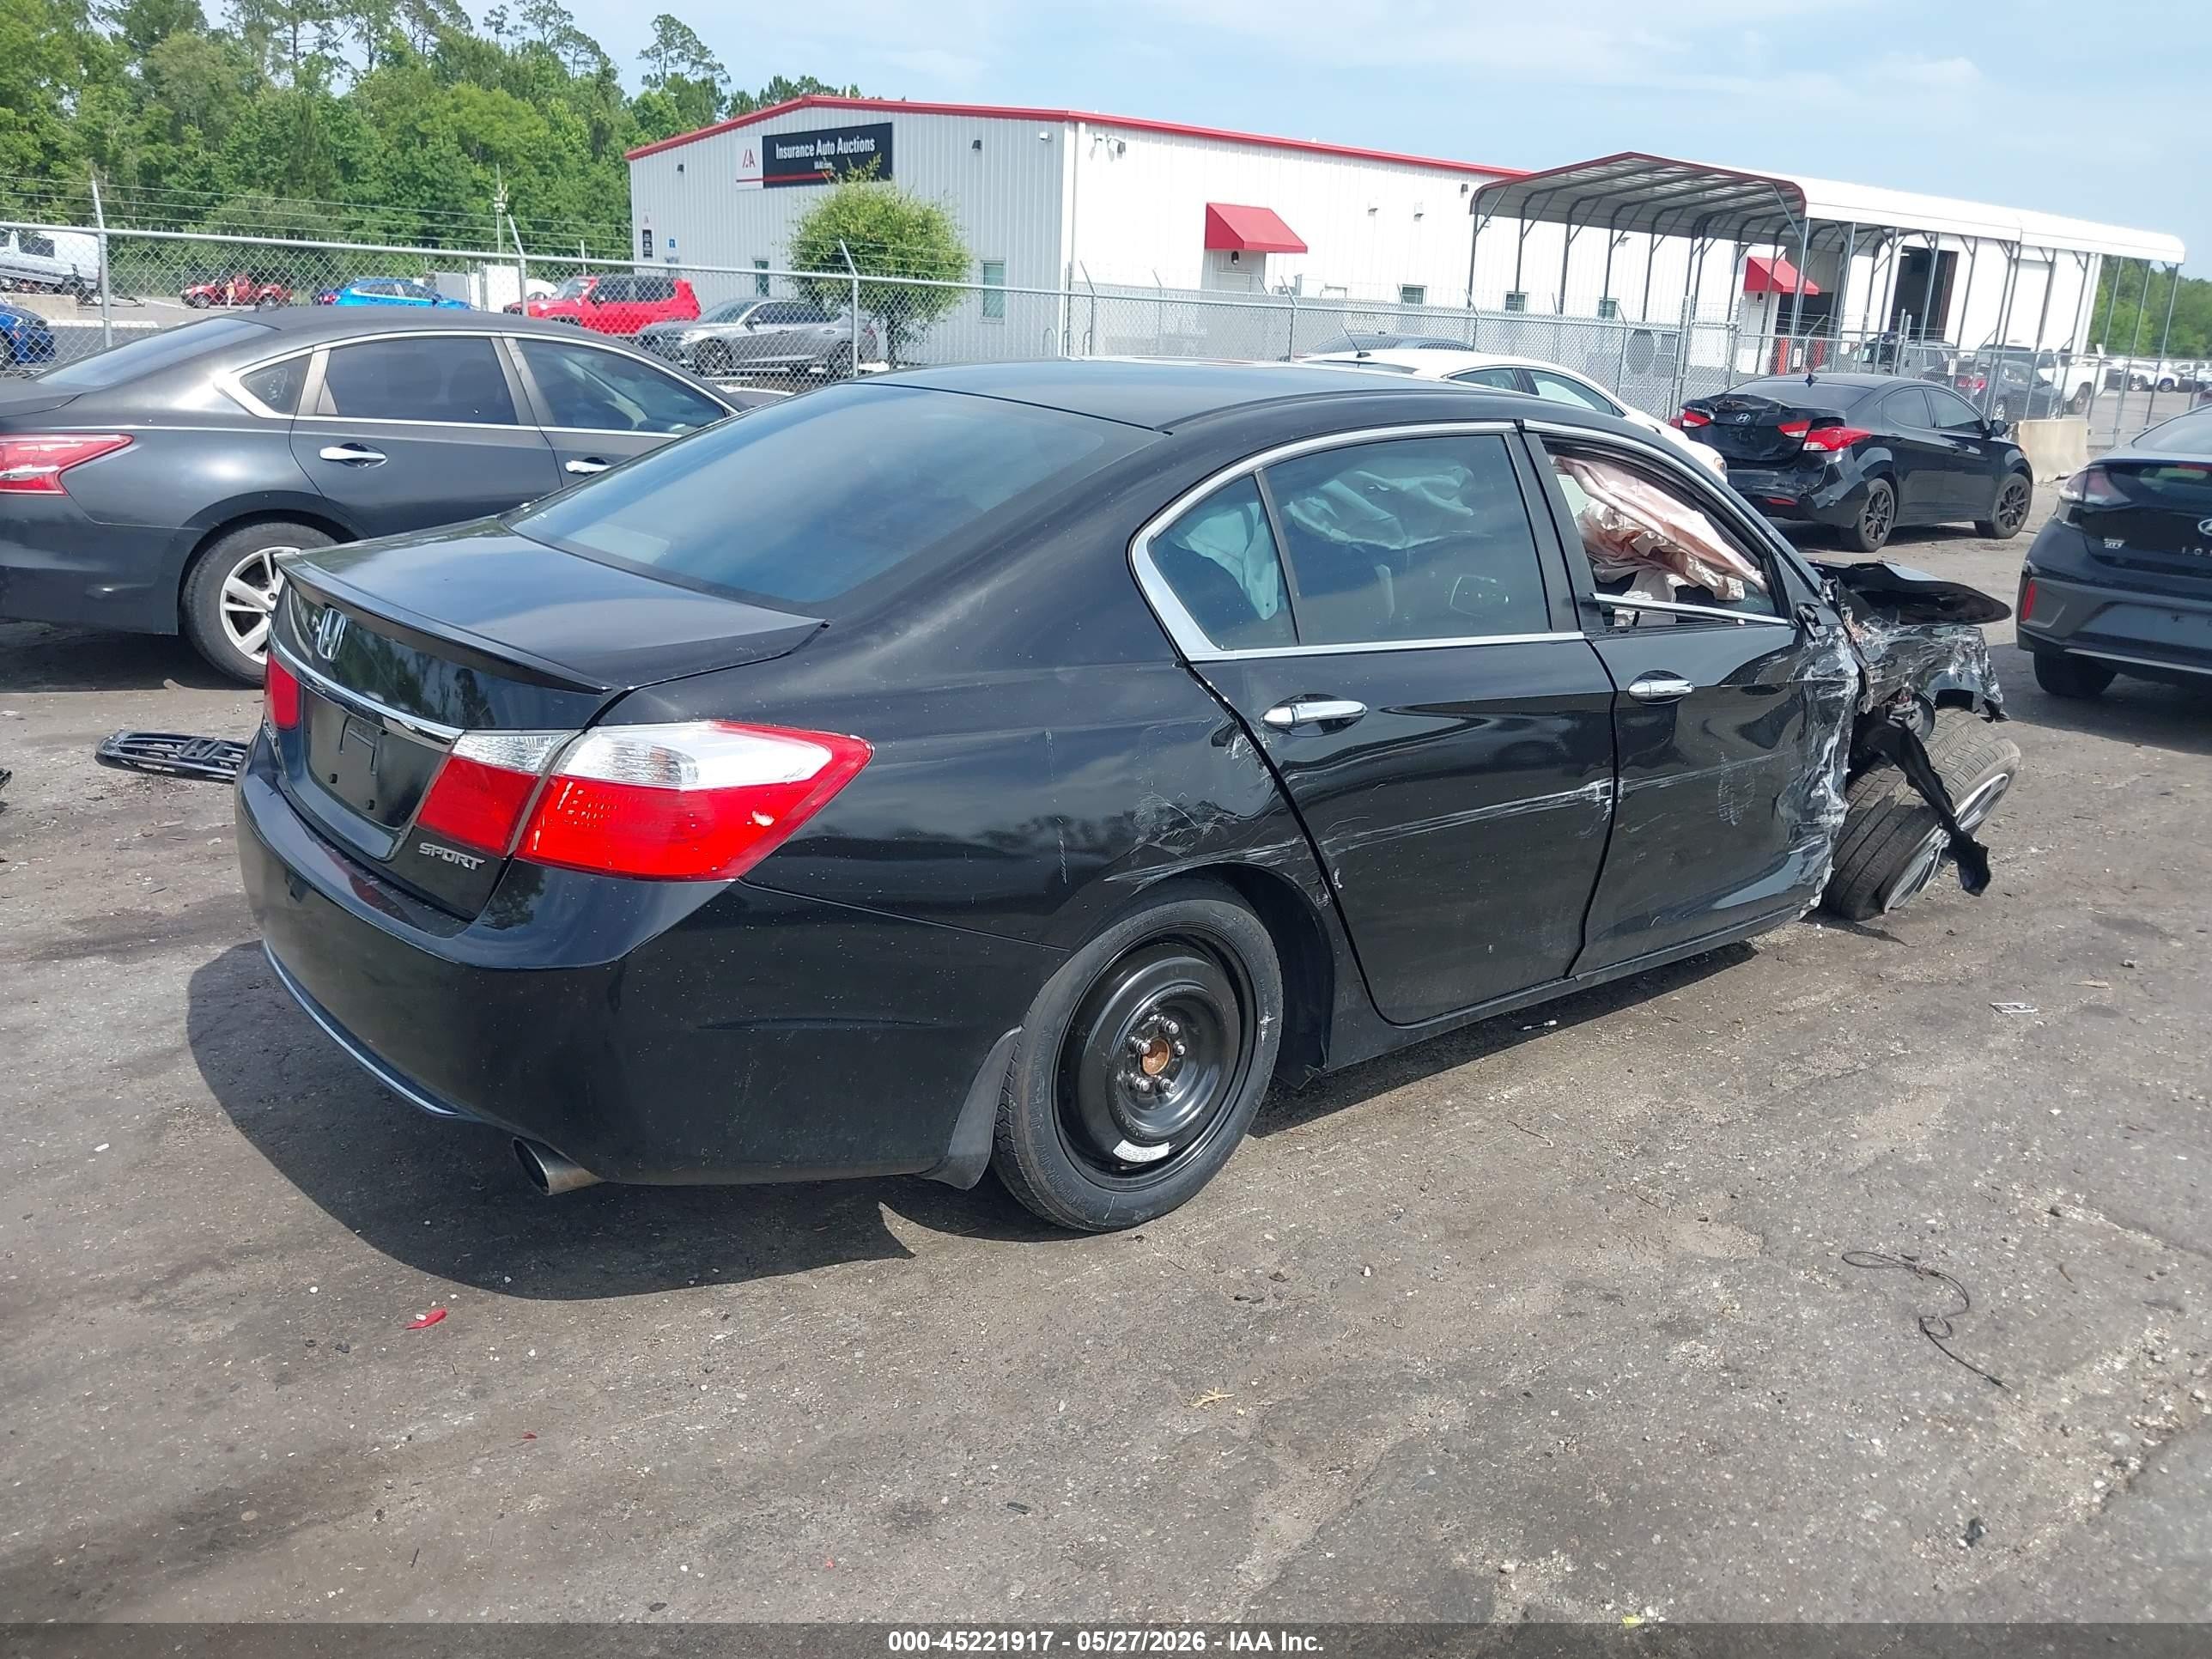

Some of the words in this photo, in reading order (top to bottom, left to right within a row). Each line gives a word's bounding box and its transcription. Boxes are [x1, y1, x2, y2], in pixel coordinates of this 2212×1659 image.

[775, 143, 815, 160] Insurance
[816, 138, 836, 156] Auto
[836, 136, 875, 155] Auctions
[418, 842, 486, 871] SPORT
